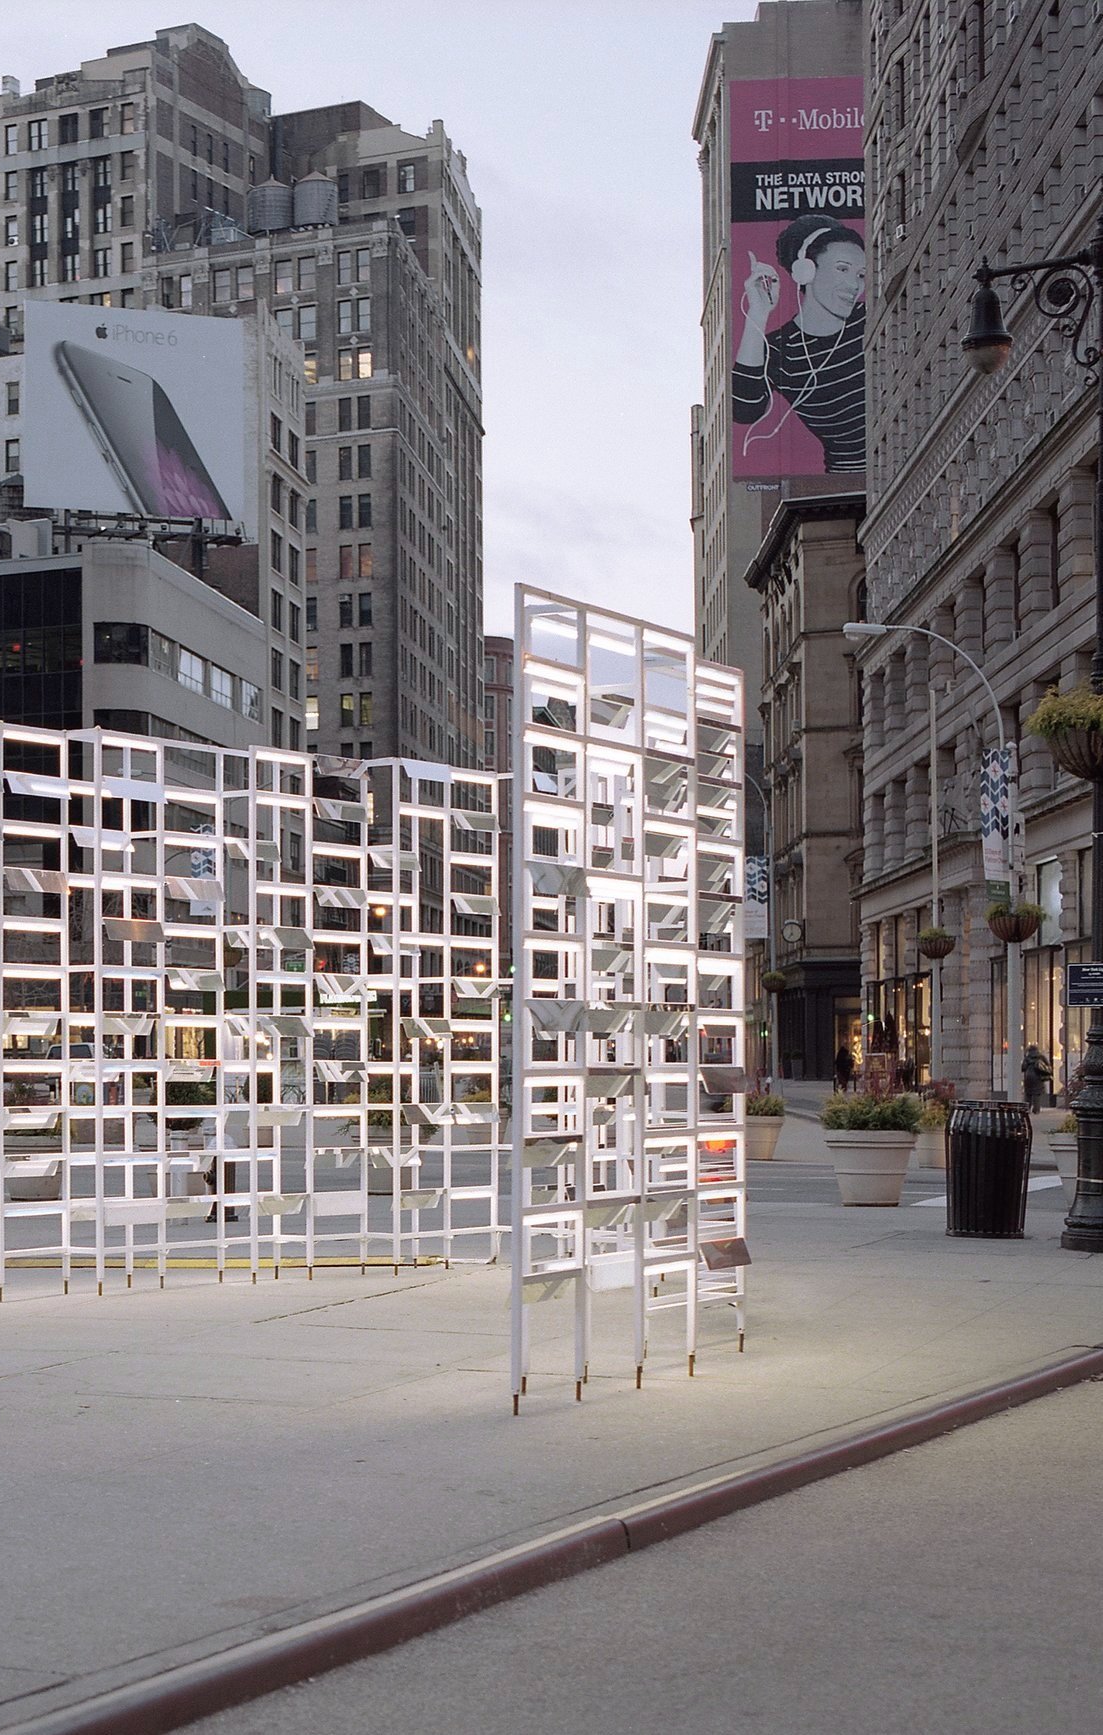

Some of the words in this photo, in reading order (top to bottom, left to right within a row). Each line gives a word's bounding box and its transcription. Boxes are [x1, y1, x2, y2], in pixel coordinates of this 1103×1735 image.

[756, 173, 783, 186] THE
[788, 173, 822, 185] DATA
[825, 171, 865, 184] STRON
[756, 185, 863, 210] NETWOR
[112, 324, 164, 345] iPhone
[167, 329, 178, 346] 6
